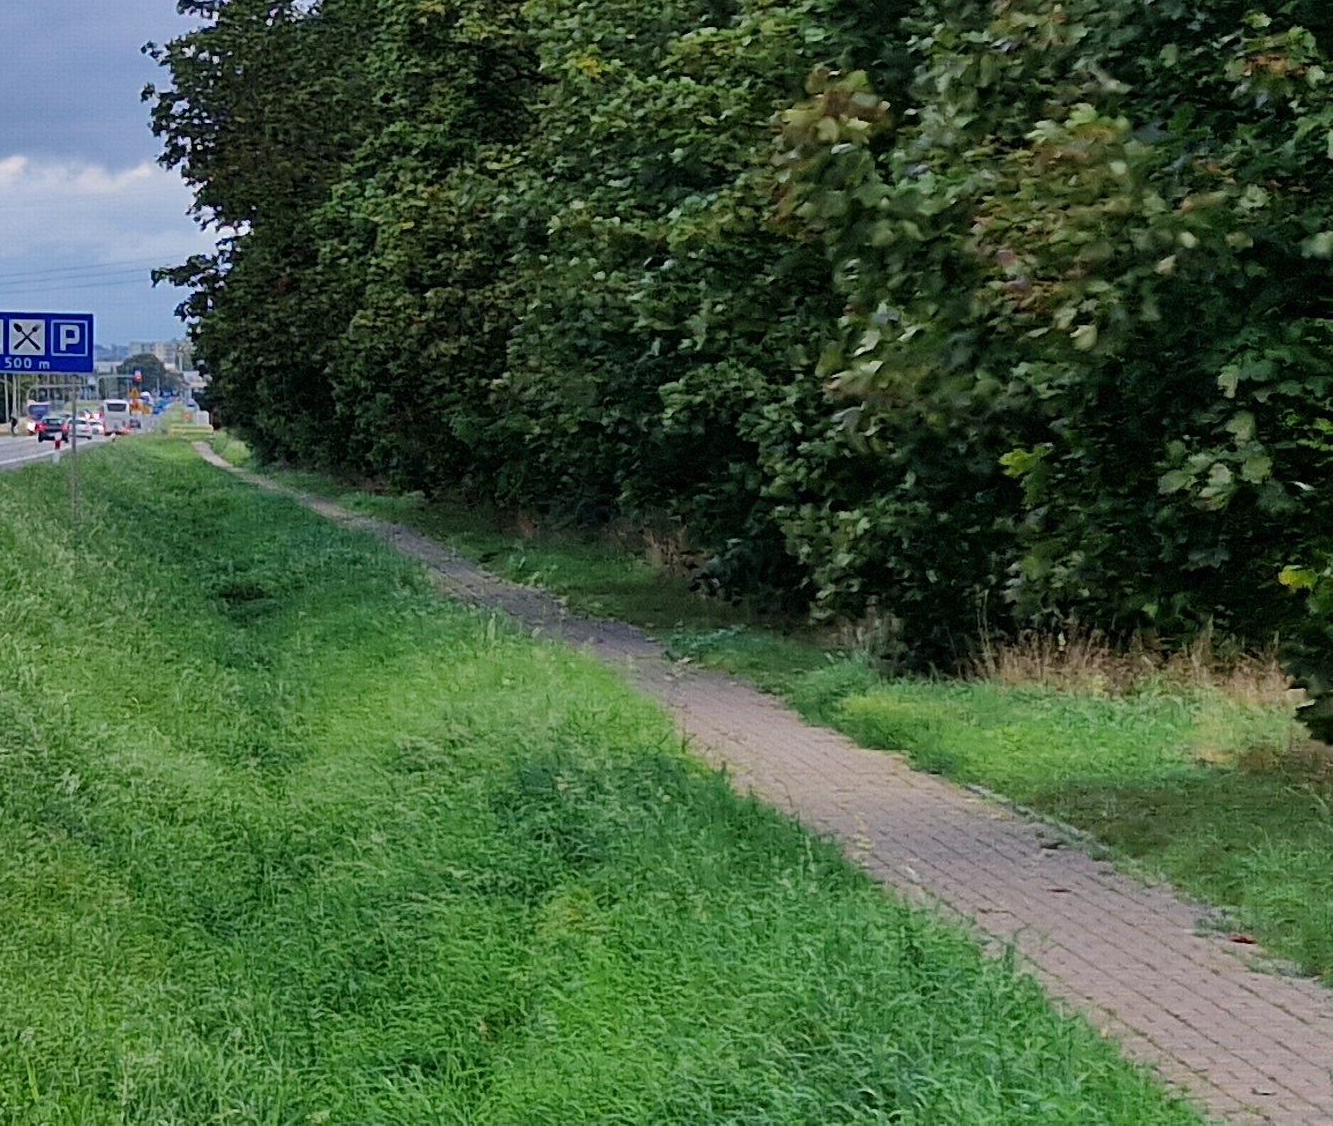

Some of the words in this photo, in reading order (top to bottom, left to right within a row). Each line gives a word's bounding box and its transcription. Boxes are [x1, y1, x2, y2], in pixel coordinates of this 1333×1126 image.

[60, 324, 80, 351] P
[4, 357, 32, 369] 500
[38, 360, 50, 370] m
